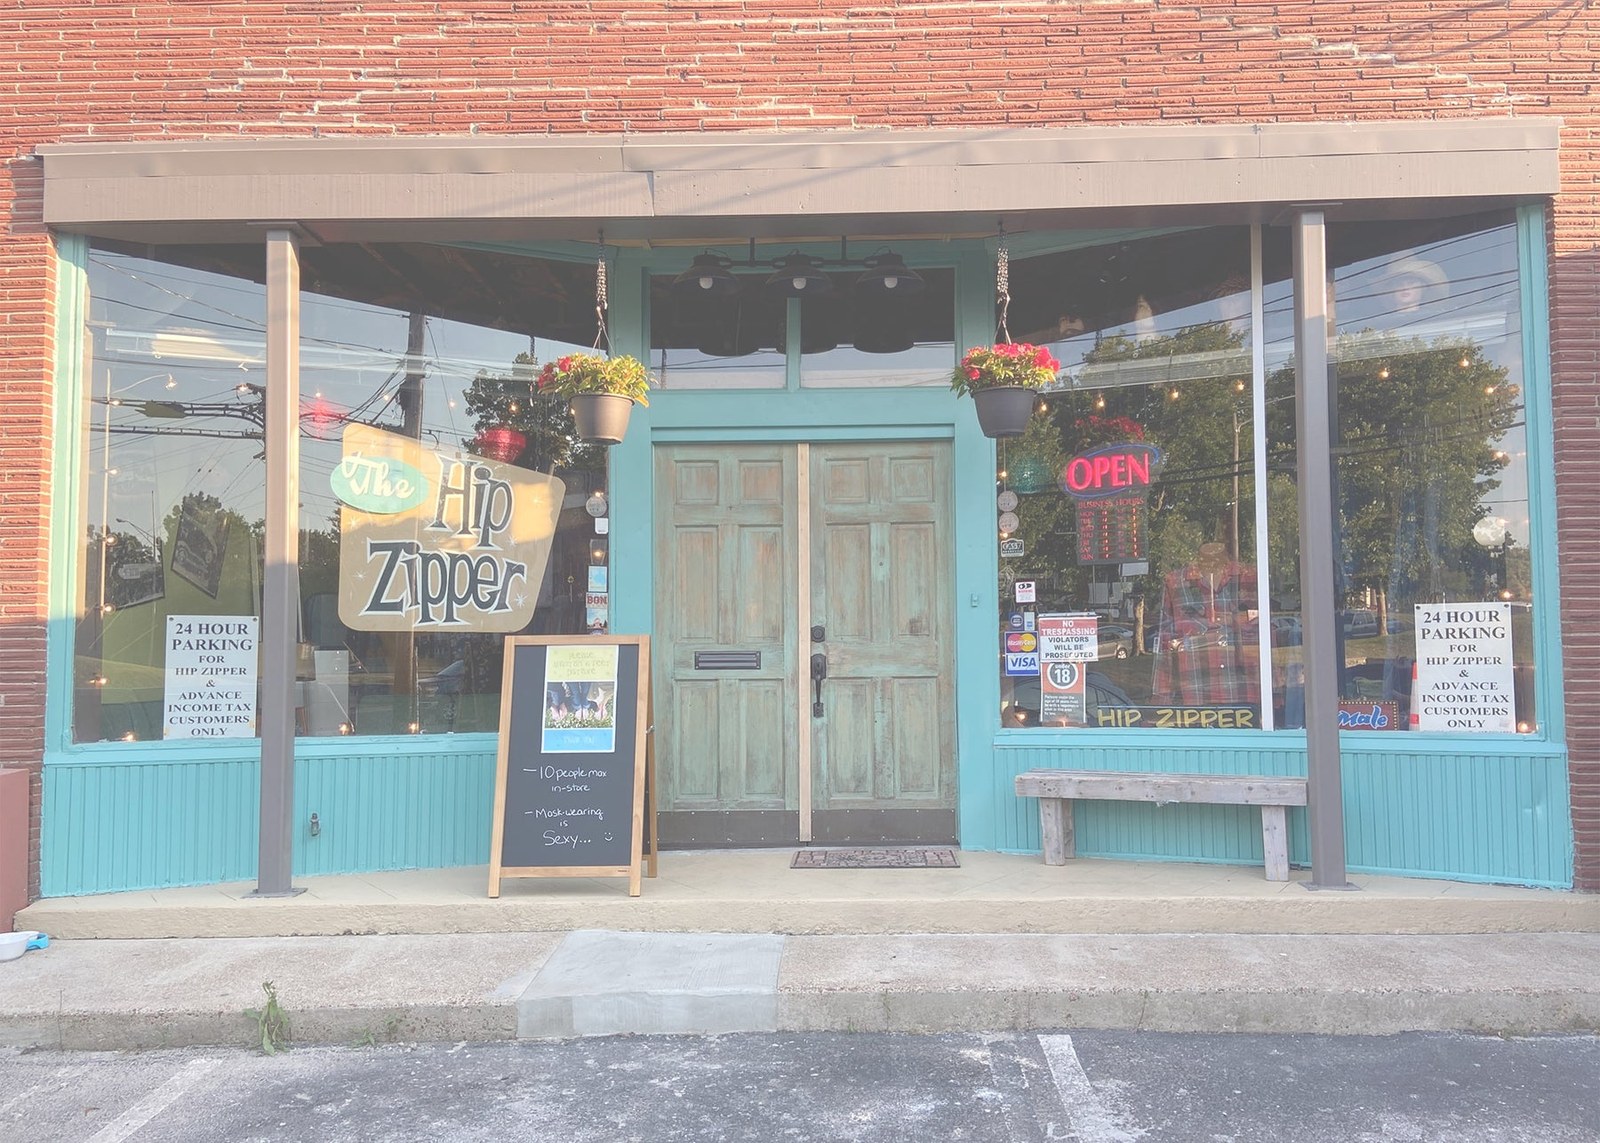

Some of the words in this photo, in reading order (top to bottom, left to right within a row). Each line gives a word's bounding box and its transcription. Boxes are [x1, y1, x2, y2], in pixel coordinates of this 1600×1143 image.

[340, 451, 416, 499] The
[1065, 452, 1150, 491] OPEN
[424, 452, 515, 551] Hip
[358, 537, 528, 628] Zipper
[1423, 611, 1441, 624] 24
[1446, 610, 1501, 623] HOUR
[175, 623, 193, 635] 24
[198, 623, 248, 635] HOUR
[1041, 627, 1096, 636] TRESPASSING
[1421, 627, 1505, 640] PARKING
[171, 639, 253, 651] PARKING
[1449, 644, 1478, 653] FOR
[199, 655, 225, 664] FOR
[1010, 656, 1037, 668] VISA
[1426, 656, 1449, 666] HIP
[1453, 656, 1502, 666] ZIPPER
[175, 667, 198, 676] HIP
[201, 667, 247, 676] ZIPPER
[1054, 669, 1071, 684] 18
[1458, 669, 1469, 678] &
[206, 679, 216, 688] &
[1432, 681, 1498, 691] ADVANCE
[178, 691, 242, 700] ADVANCE
[1422, 694, 1478, 703] INCOME
[1480, 694, 1510, 703] TAX
[168, 703, 222, 713] INCOME
[225, 703, 251, 712] TAX
[1424, 707, 1509, 716] CUSTOMERS
[169, 715, 250, 725] CUSTOMERS
[1097, 708, 1142, 728] HIP
[1156, 708, 1254, 729] ZIPPER
[1447, 719, 1486, 728] ONLY
[191, 727, 228, 736] ONLY
[551, 784, 590, 792] in-store
[560, 819, 569, 827] is
